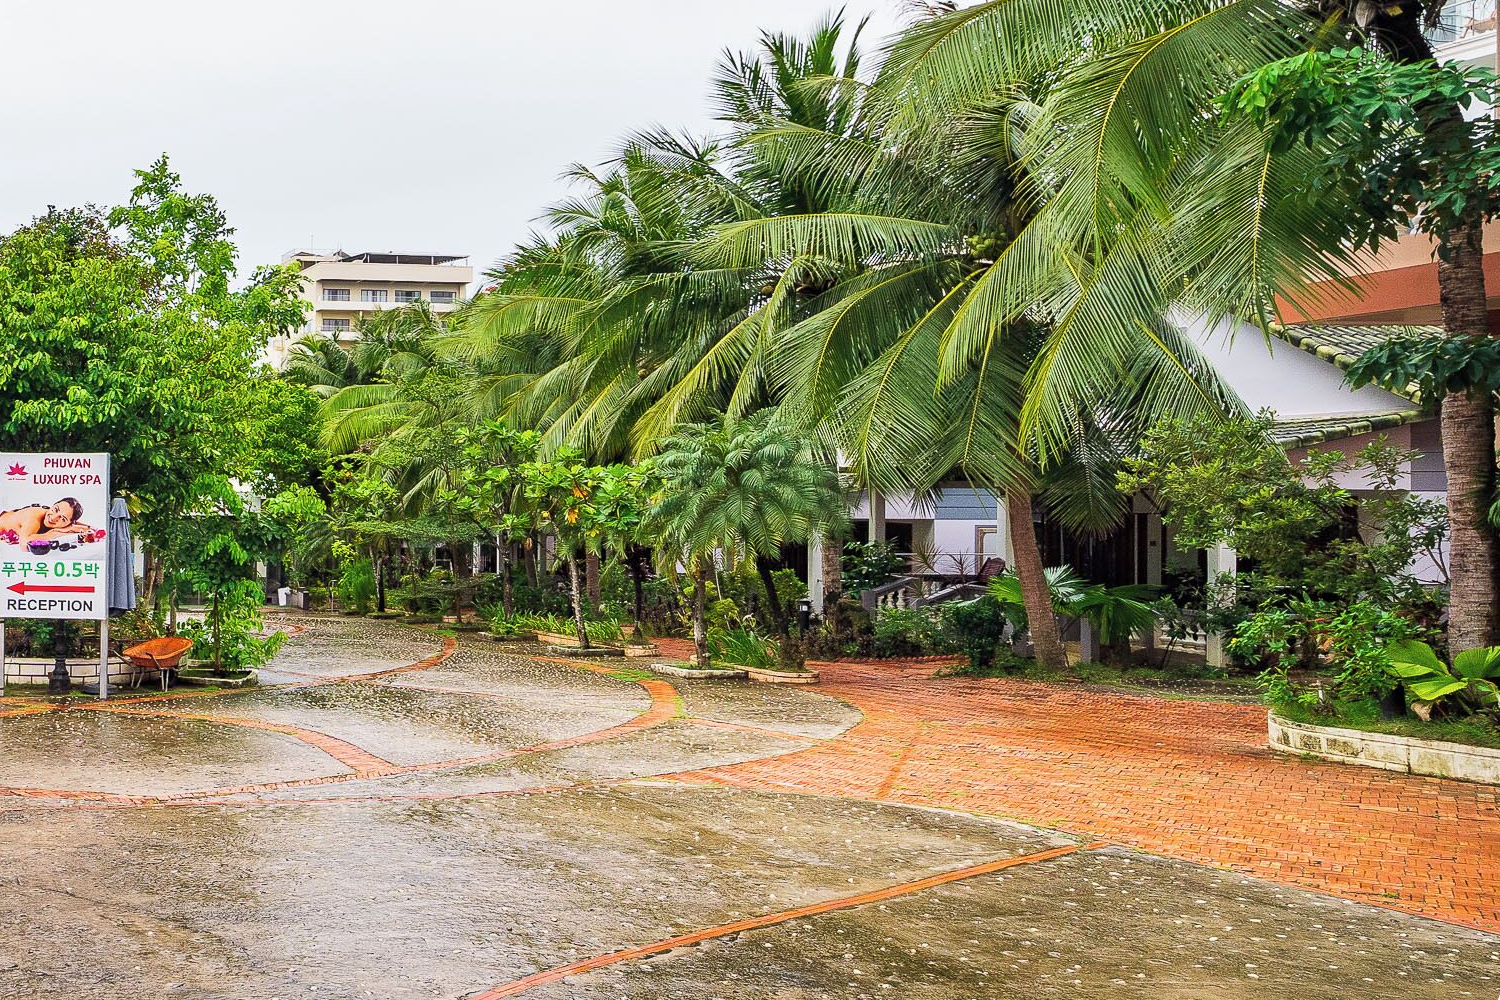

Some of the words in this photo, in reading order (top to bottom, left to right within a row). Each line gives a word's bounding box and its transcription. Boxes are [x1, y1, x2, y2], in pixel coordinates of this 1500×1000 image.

[43, 457, 91, 469] PHUVAN
[33, 474, 77, 485] LUXURY
[79, 474, 102, 485] SPA
[1, 562, 49, 578] 푸꾸옥
[53, 561, 100, 579] 0.5박
[7, 598, 93, 612] RECEPTION
